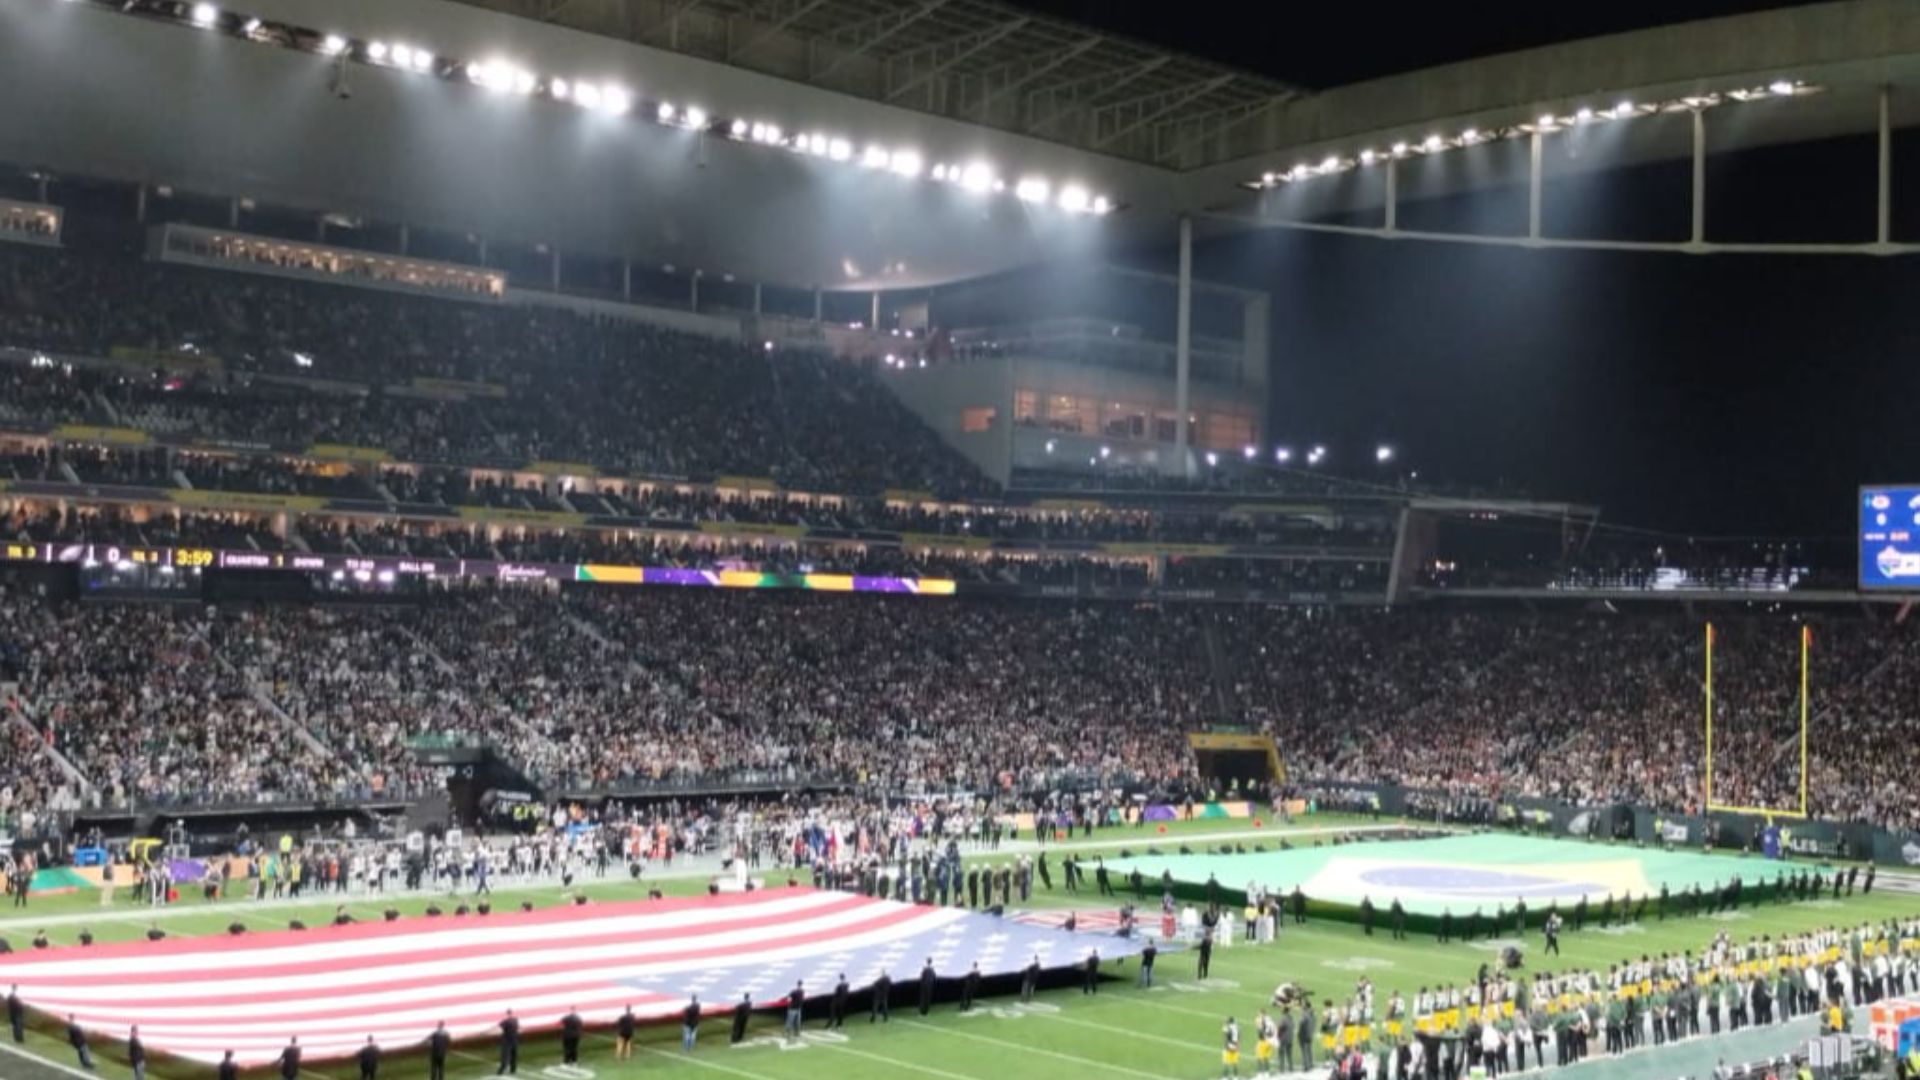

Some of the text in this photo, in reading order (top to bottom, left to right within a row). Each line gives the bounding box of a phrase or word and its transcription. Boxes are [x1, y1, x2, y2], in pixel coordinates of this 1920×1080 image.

[108, 546, 120, 563] 0
[176, 547, 213, 566] 3:59
[226, 555, 283, 567] QUARTER 1
[293, 557, 324, 569] DOWN
